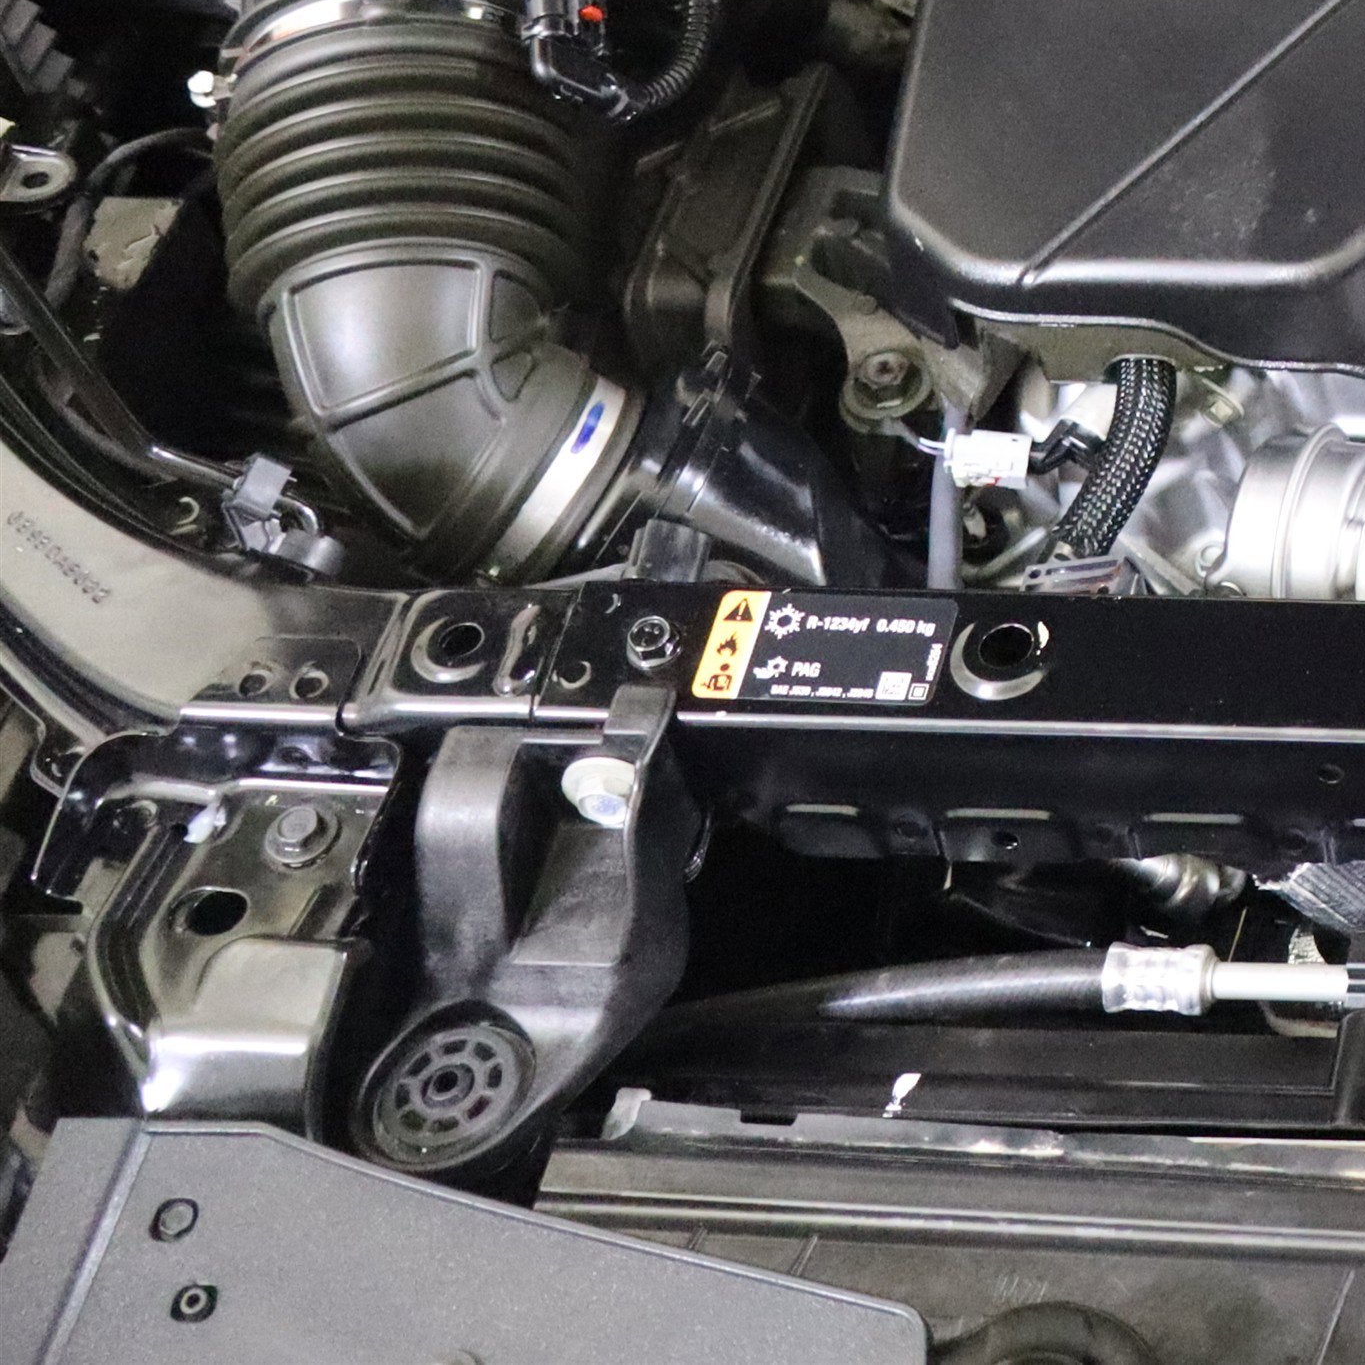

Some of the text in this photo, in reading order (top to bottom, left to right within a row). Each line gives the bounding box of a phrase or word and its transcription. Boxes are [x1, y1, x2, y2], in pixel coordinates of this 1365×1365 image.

[806, 615, 870, 634] R-1234yf
[917, 620, 936, 637] kg
[791, 661, 821, 678] PAG
